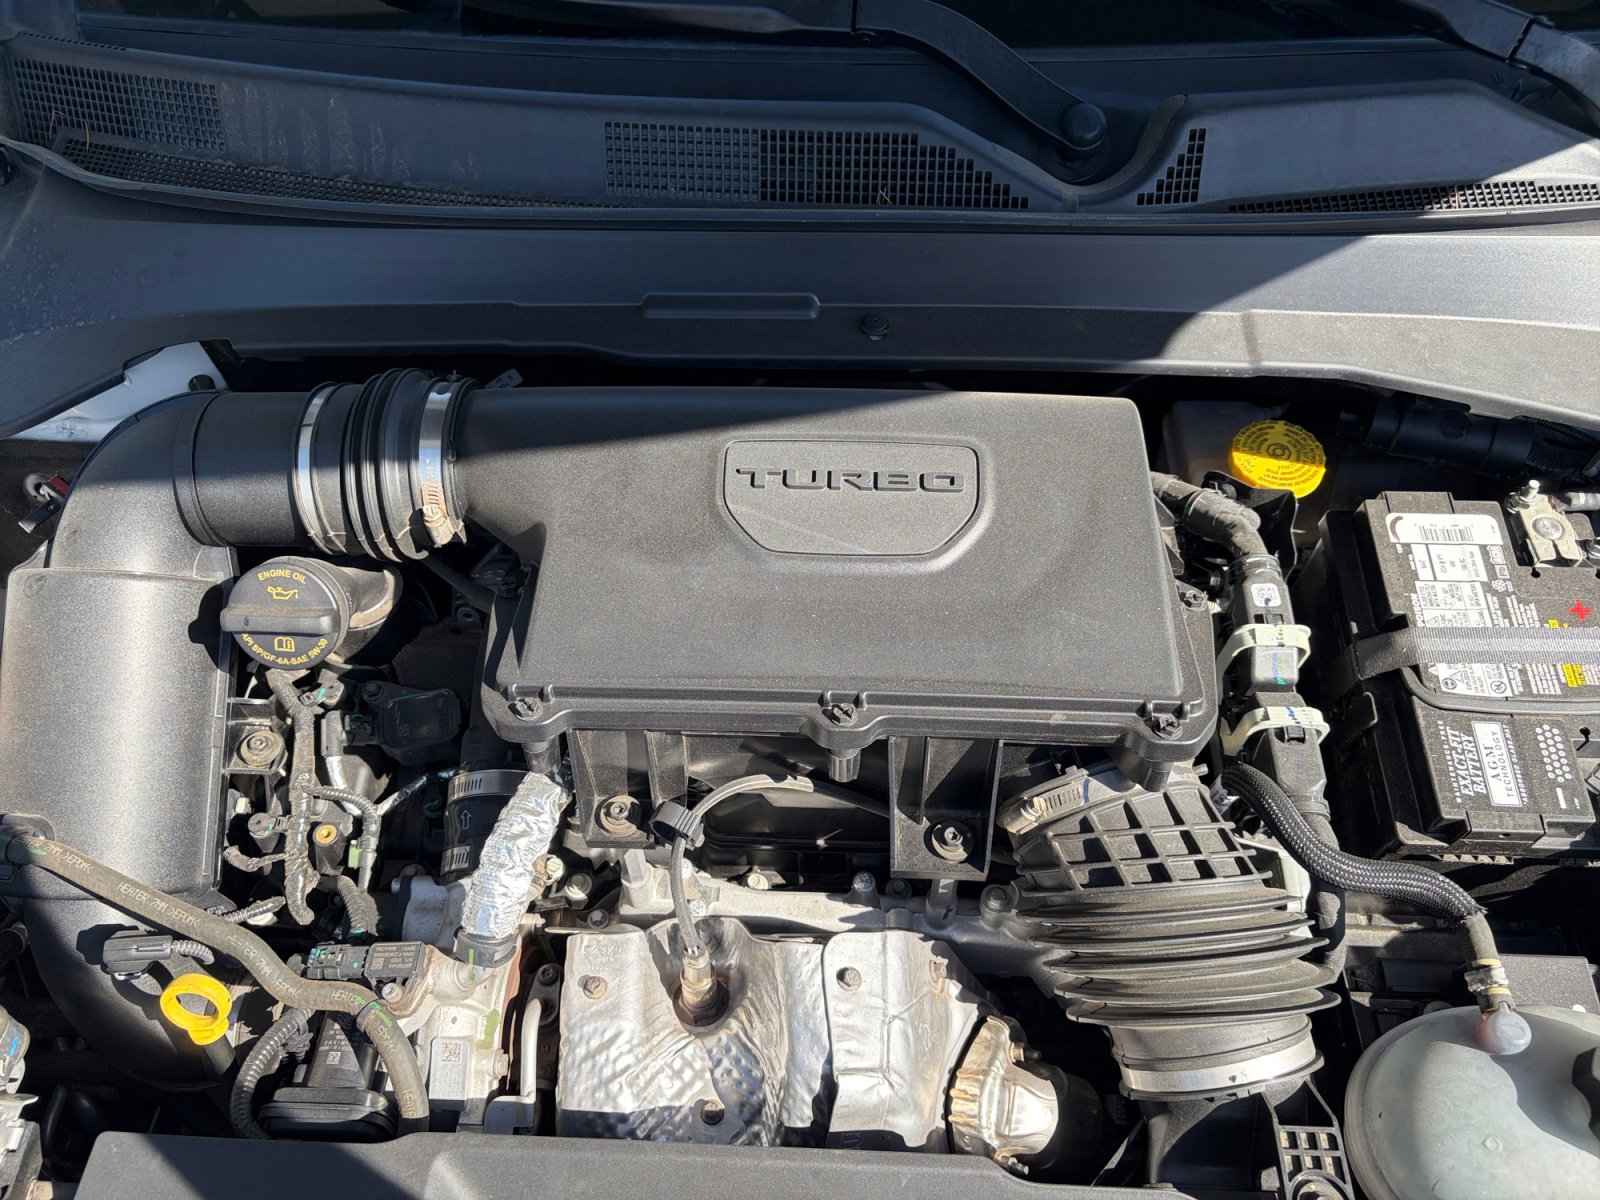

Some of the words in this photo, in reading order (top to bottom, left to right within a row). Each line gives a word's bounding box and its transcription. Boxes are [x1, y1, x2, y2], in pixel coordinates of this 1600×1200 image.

[736, 468, 964, 492] TURBO
[257, 569, 291, 581] ENGINE
[292, 572, 306, 584] OIL
[1410, 593, 1426, 626] POISON
[242, 633, 253, 646] API
[307, 638, 328, 658] 5W-30
[1446, 726, 1474, 796] EXACT-FIT
[1460, 733, 1487, 794] BATTERY
[1491, 731, 1515, 798] TECHNOLOGY
[117, 881, 150, 903] HEATER
